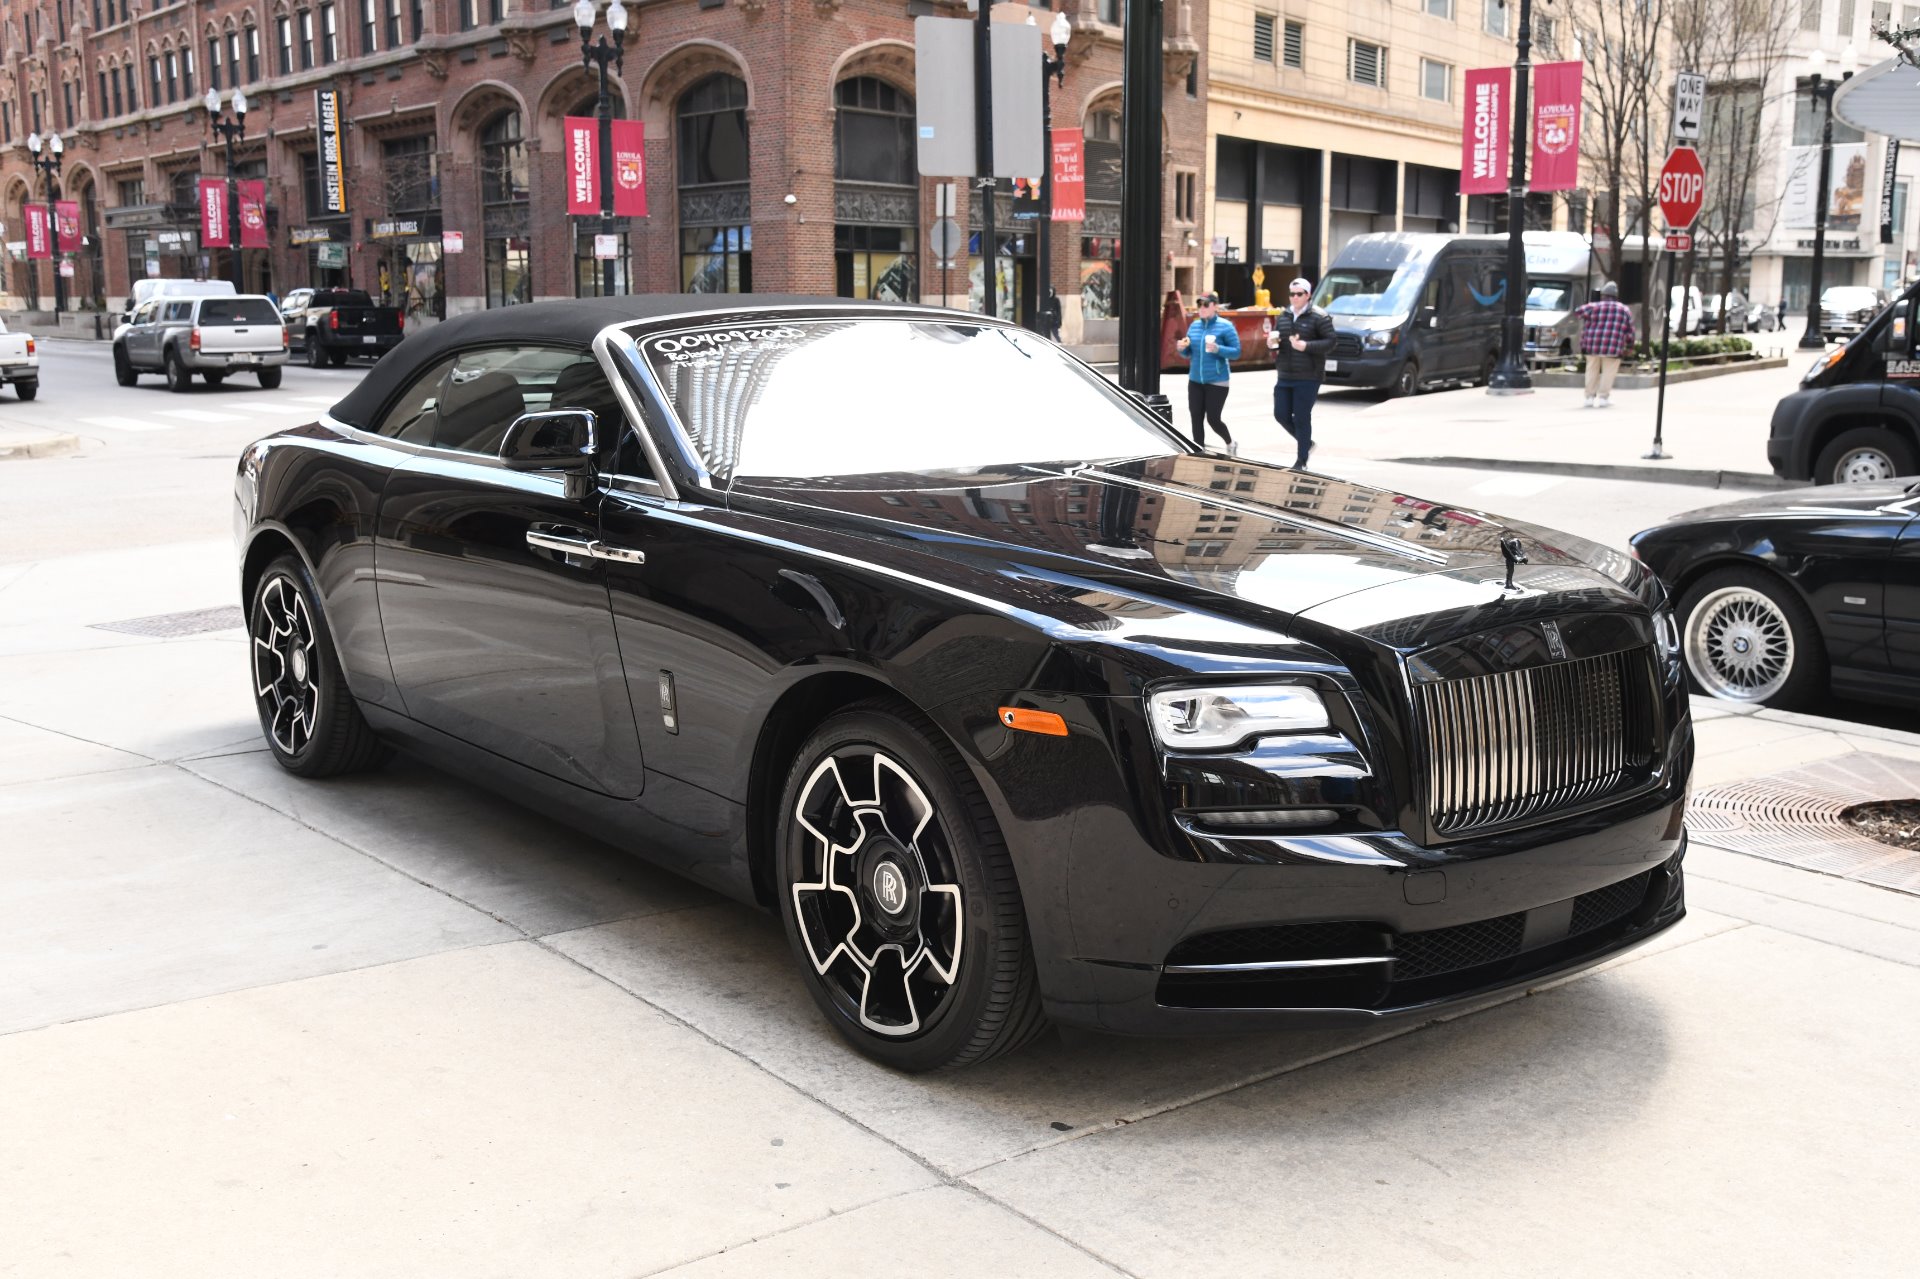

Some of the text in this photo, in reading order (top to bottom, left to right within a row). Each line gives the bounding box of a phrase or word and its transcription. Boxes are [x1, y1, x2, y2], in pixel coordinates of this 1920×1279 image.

[1678, 97, 1700, 113] WAY
[1680, 78, 1701, 95] ONE
[322, 92, 336, 132] BAGELS
[1539, 104, 1574, 114] LOYOLA
[1473, 83, 1490, 178] WELCOME
[573, 129, 587, 203] WELCOME
[1885, 136, 1896, 195] ORDSTROM
[327, 164, 340, 210] EINSTEIN
[1661, 172, 1703, 204] STOP
[206, 187, 218, 239] WELCOME
[1667, 237, 1677, 249] ALL
[1678, 238, 1689, 249] WAY
[882, 870, 898, 905] RR
